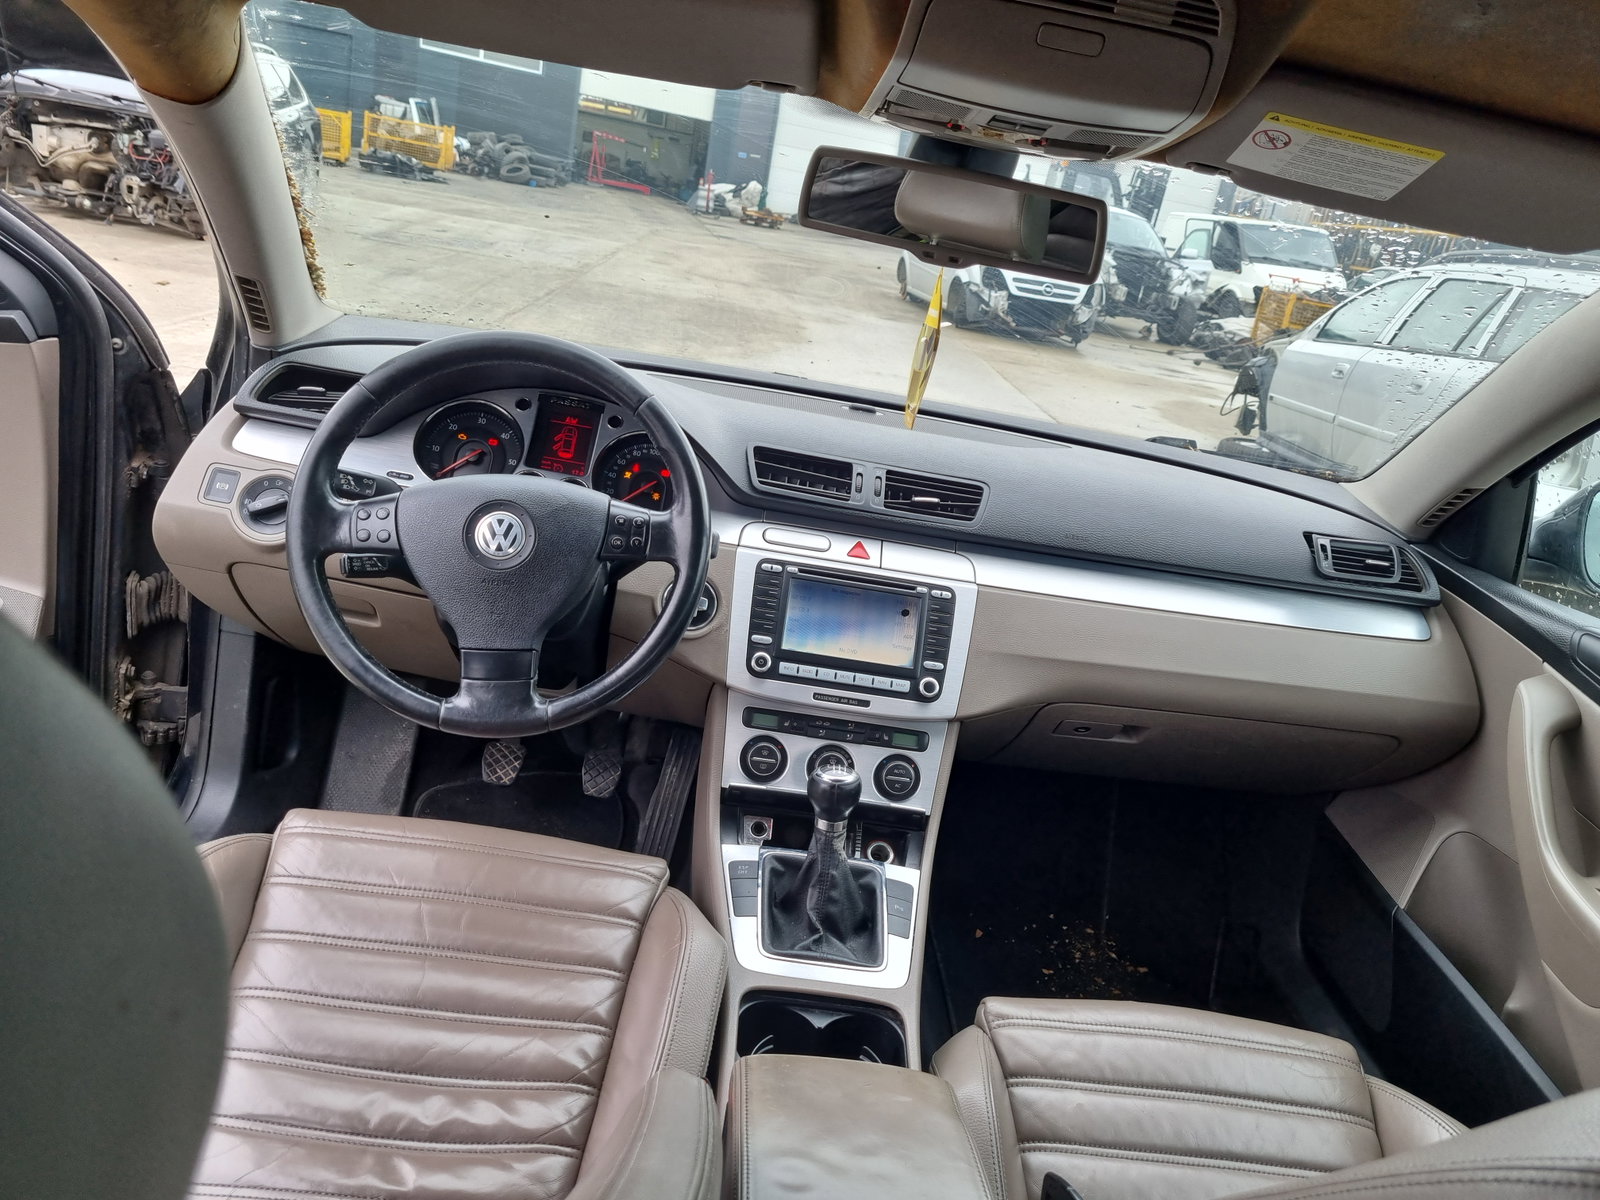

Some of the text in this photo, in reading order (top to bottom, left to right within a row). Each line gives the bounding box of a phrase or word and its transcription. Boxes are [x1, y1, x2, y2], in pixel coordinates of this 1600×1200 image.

[477, 417, 487, 425] 30
[448, 423, 458, 431] 20
[500, 432, 510, 440] 40
[431, 444, 440, 452] 10
[507, 458, 517, 466] 50
[814, 694, 840, 702] PASSENGER
